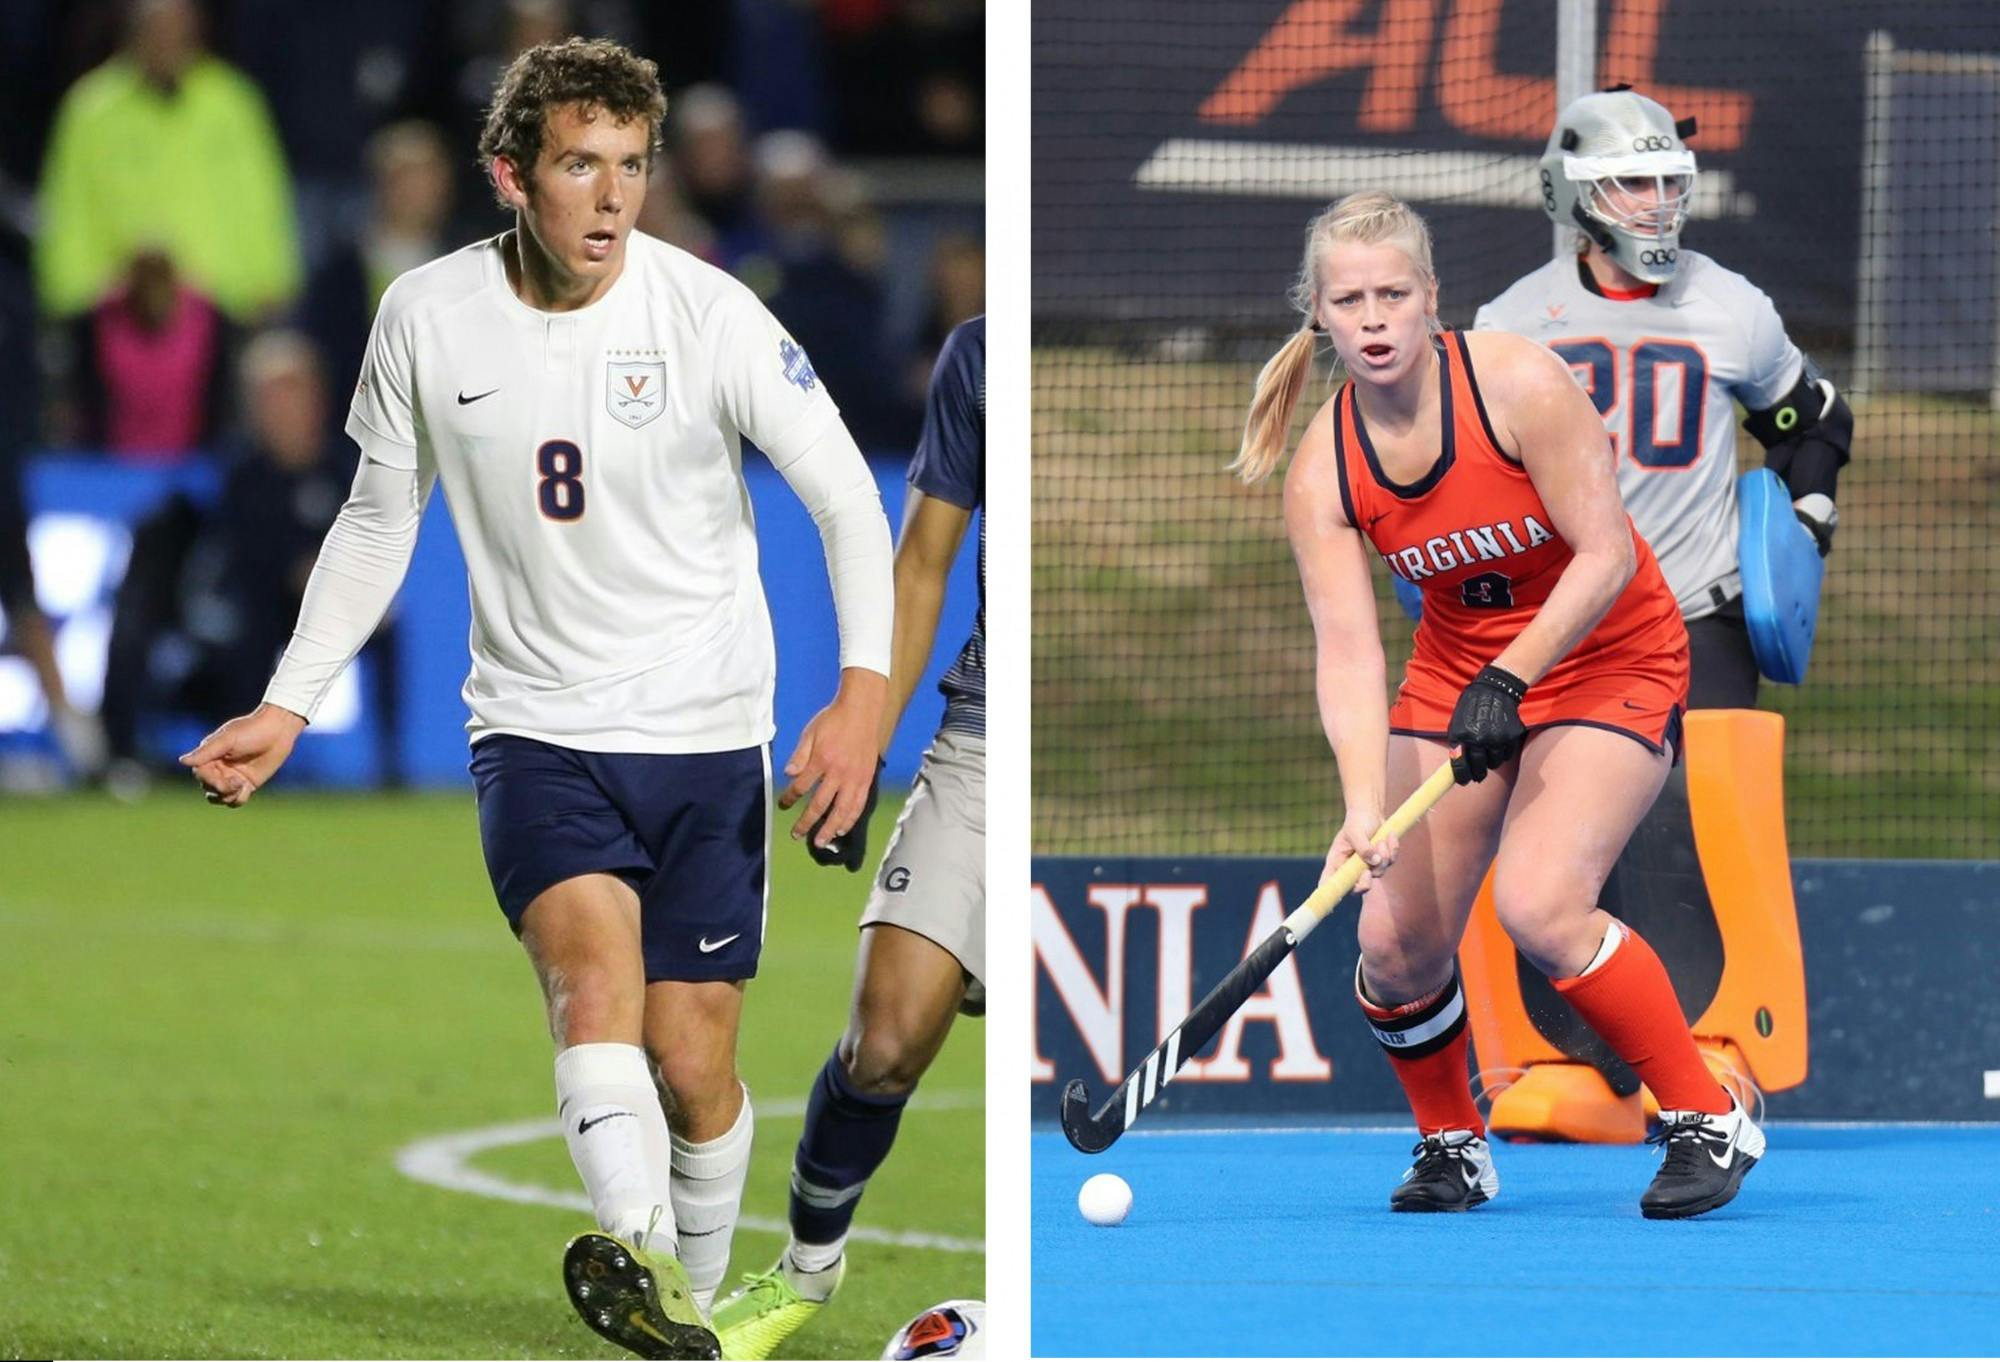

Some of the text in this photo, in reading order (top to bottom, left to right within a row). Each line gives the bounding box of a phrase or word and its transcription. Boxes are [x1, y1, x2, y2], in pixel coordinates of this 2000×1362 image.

[1633, 136, 1672, 152] OBO
[1640, 249, 1677, 266] OBO
[624, 375, 651, 398] V
[536, 439, 585, 523] 8
[1382, 515, 1554, 581] IRGINIA
[884, 865, 912, 895] G
[1031, 880, 1333, 1084] NIA
